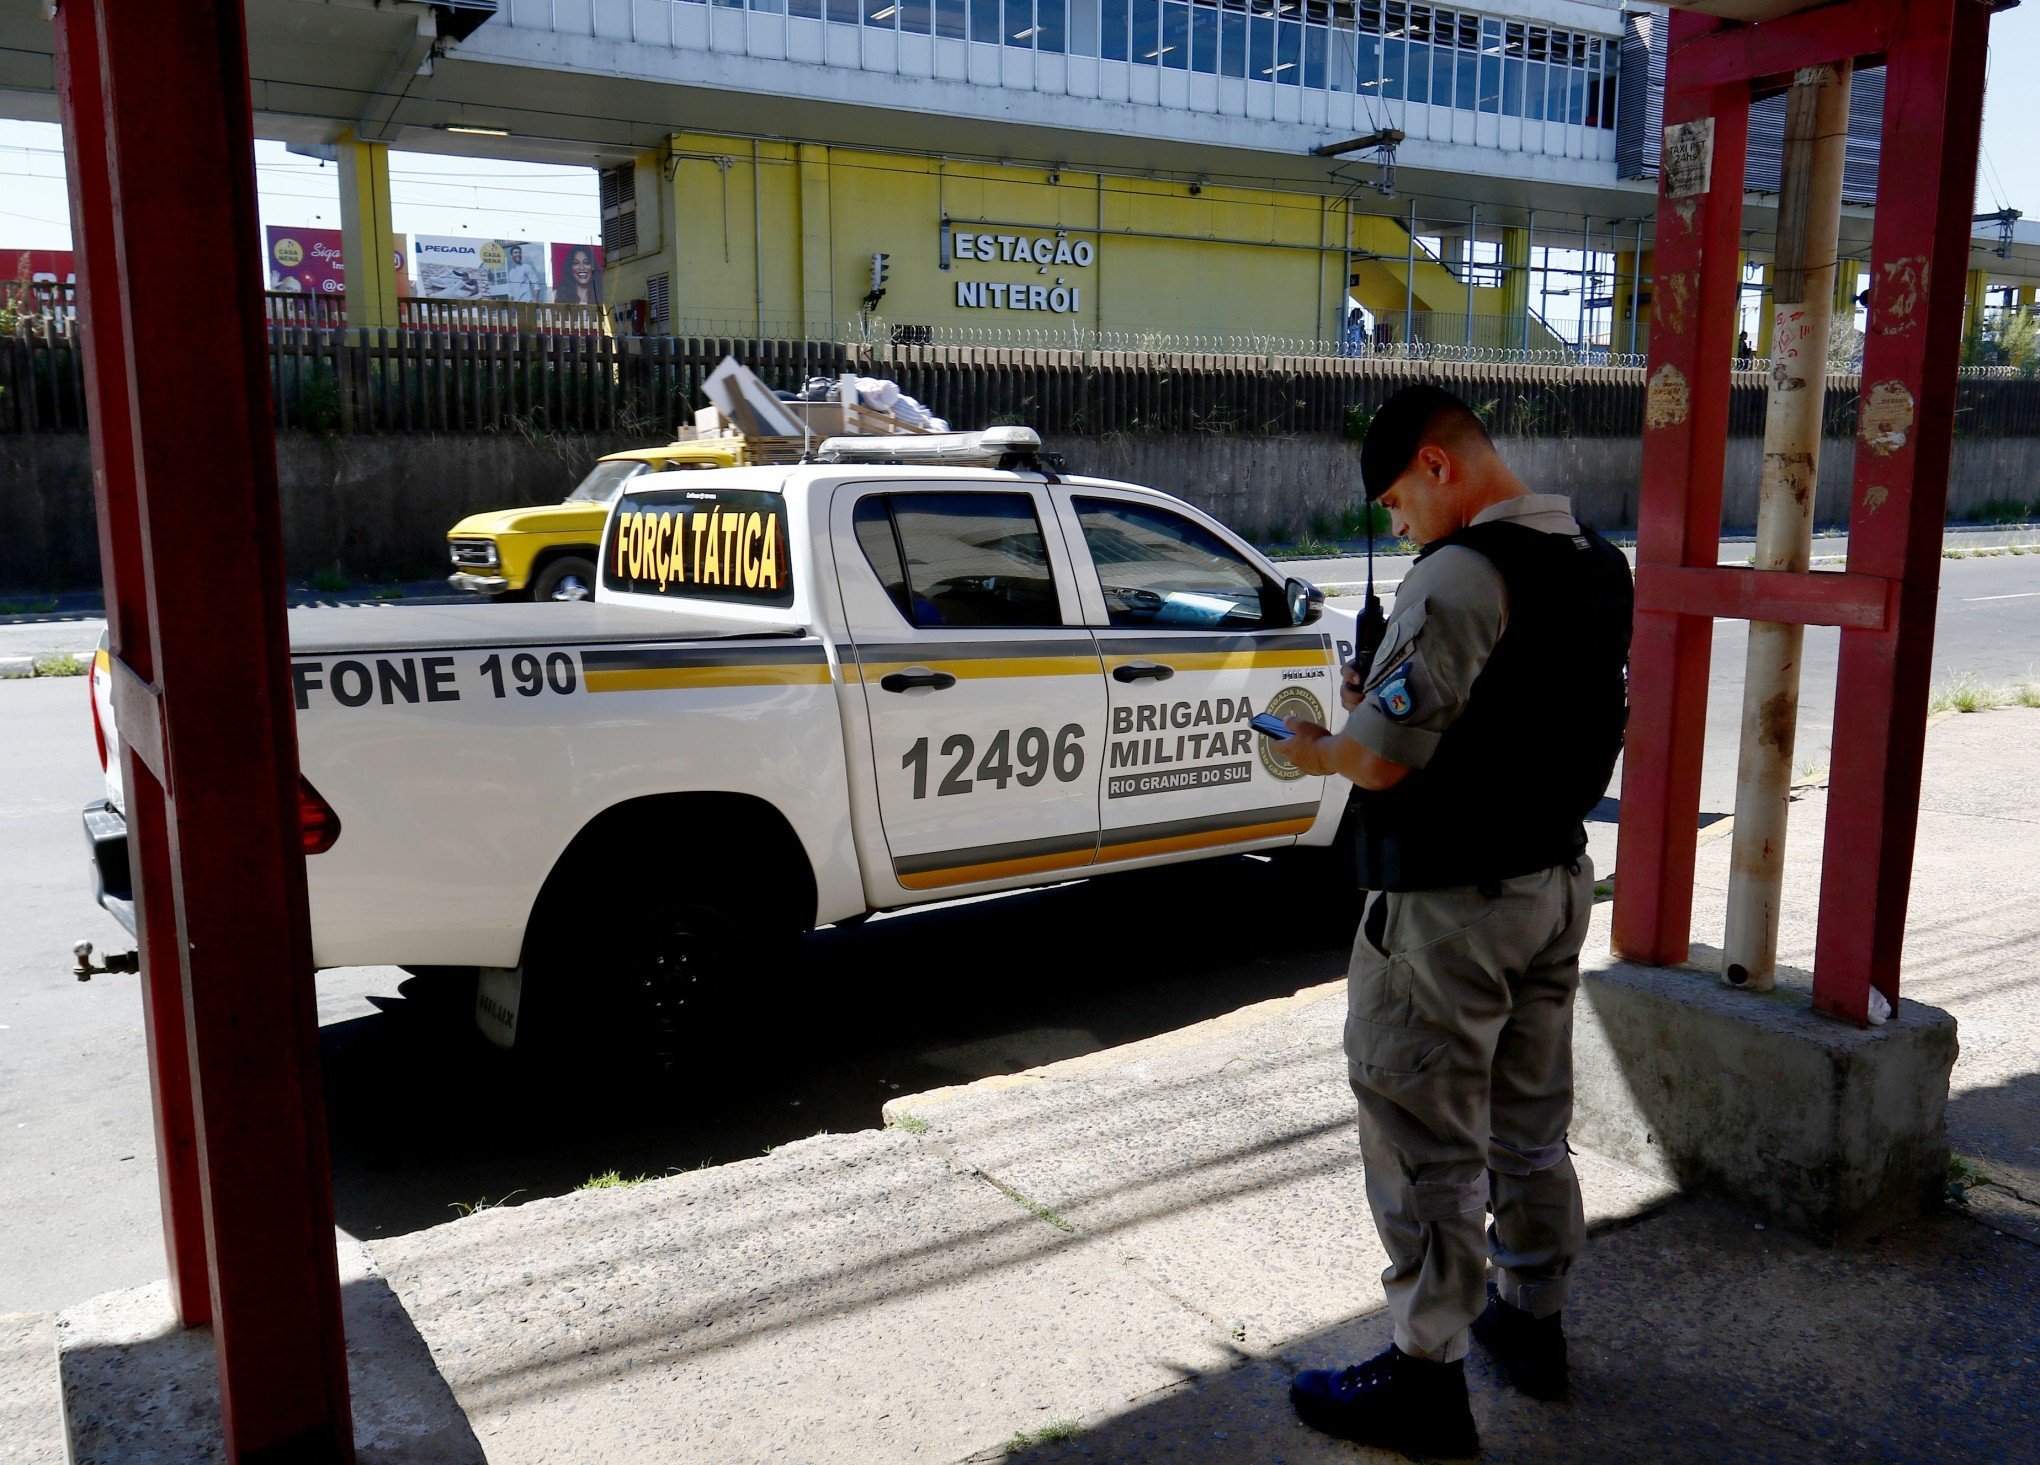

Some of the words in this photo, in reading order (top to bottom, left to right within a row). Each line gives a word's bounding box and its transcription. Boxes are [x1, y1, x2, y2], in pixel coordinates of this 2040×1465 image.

[1670, 145, 1688, 155] TAXI
[311, 242, 341, 262] Siga
[425, 245, 476, 254] PEGADA
[954, 229, 1094, 275] ESTAÇÃO
[956, 276, 1079, 313] NITERÓI
[617, 511, 685, 593] FORÇA
[691, 504, 777, 590] TÁTICA
[292, 656, 461, 709] FONE
[479, 651, 577, 699] 190
[1282, 668, 1325, 681] HILUX
[1113, 696, 1254, 734] BRIGADA
[901, 722, 1085, 800] 12496
[1110, 729, 1253, 768] MILITAR
[1110, 781, 1136, 794] RIO
[1140, 772, 1198, 791] GRANDE
[1201, 769, 1220, 783] DO
[1223, 766, 1250, 780] SUL
